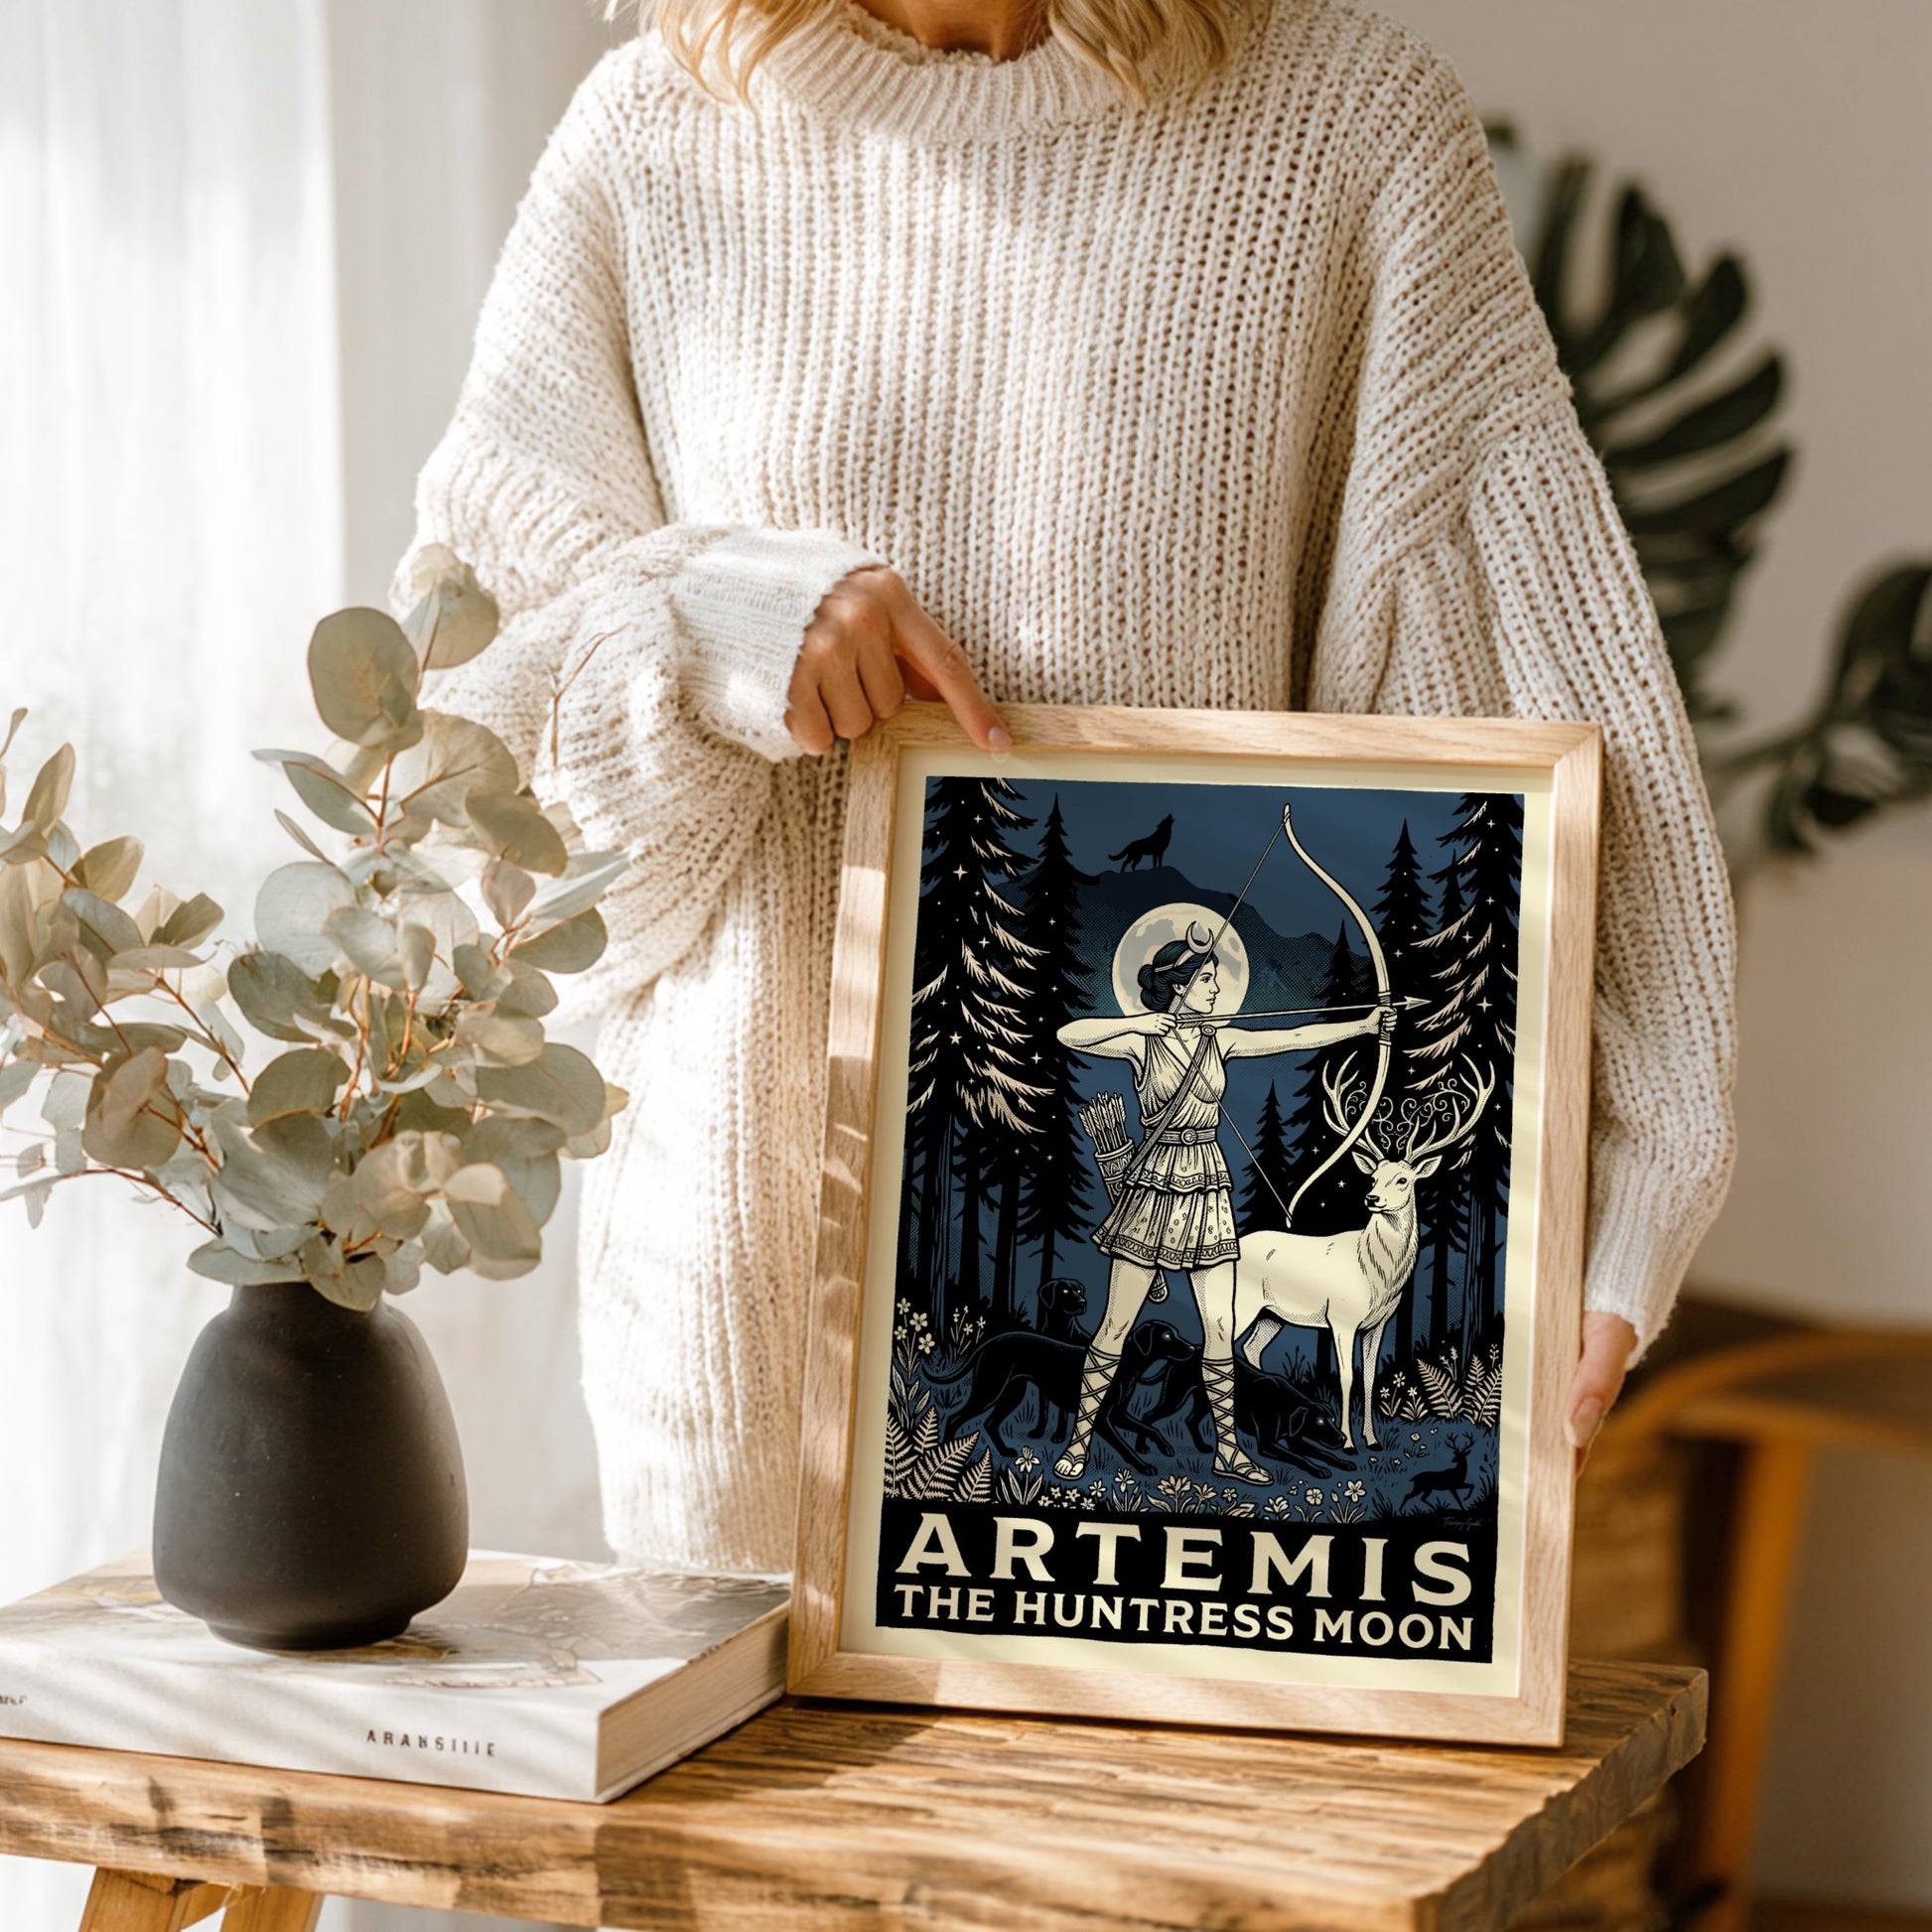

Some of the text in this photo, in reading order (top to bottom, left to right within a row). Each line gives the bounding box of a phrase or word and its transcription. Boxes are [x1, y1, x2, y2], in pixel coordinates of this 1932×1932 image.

[895, 1512, 1472, 1606] ARTEMIS
[894, 1584, 1473, 1651] THE HUNTRESS MOON
